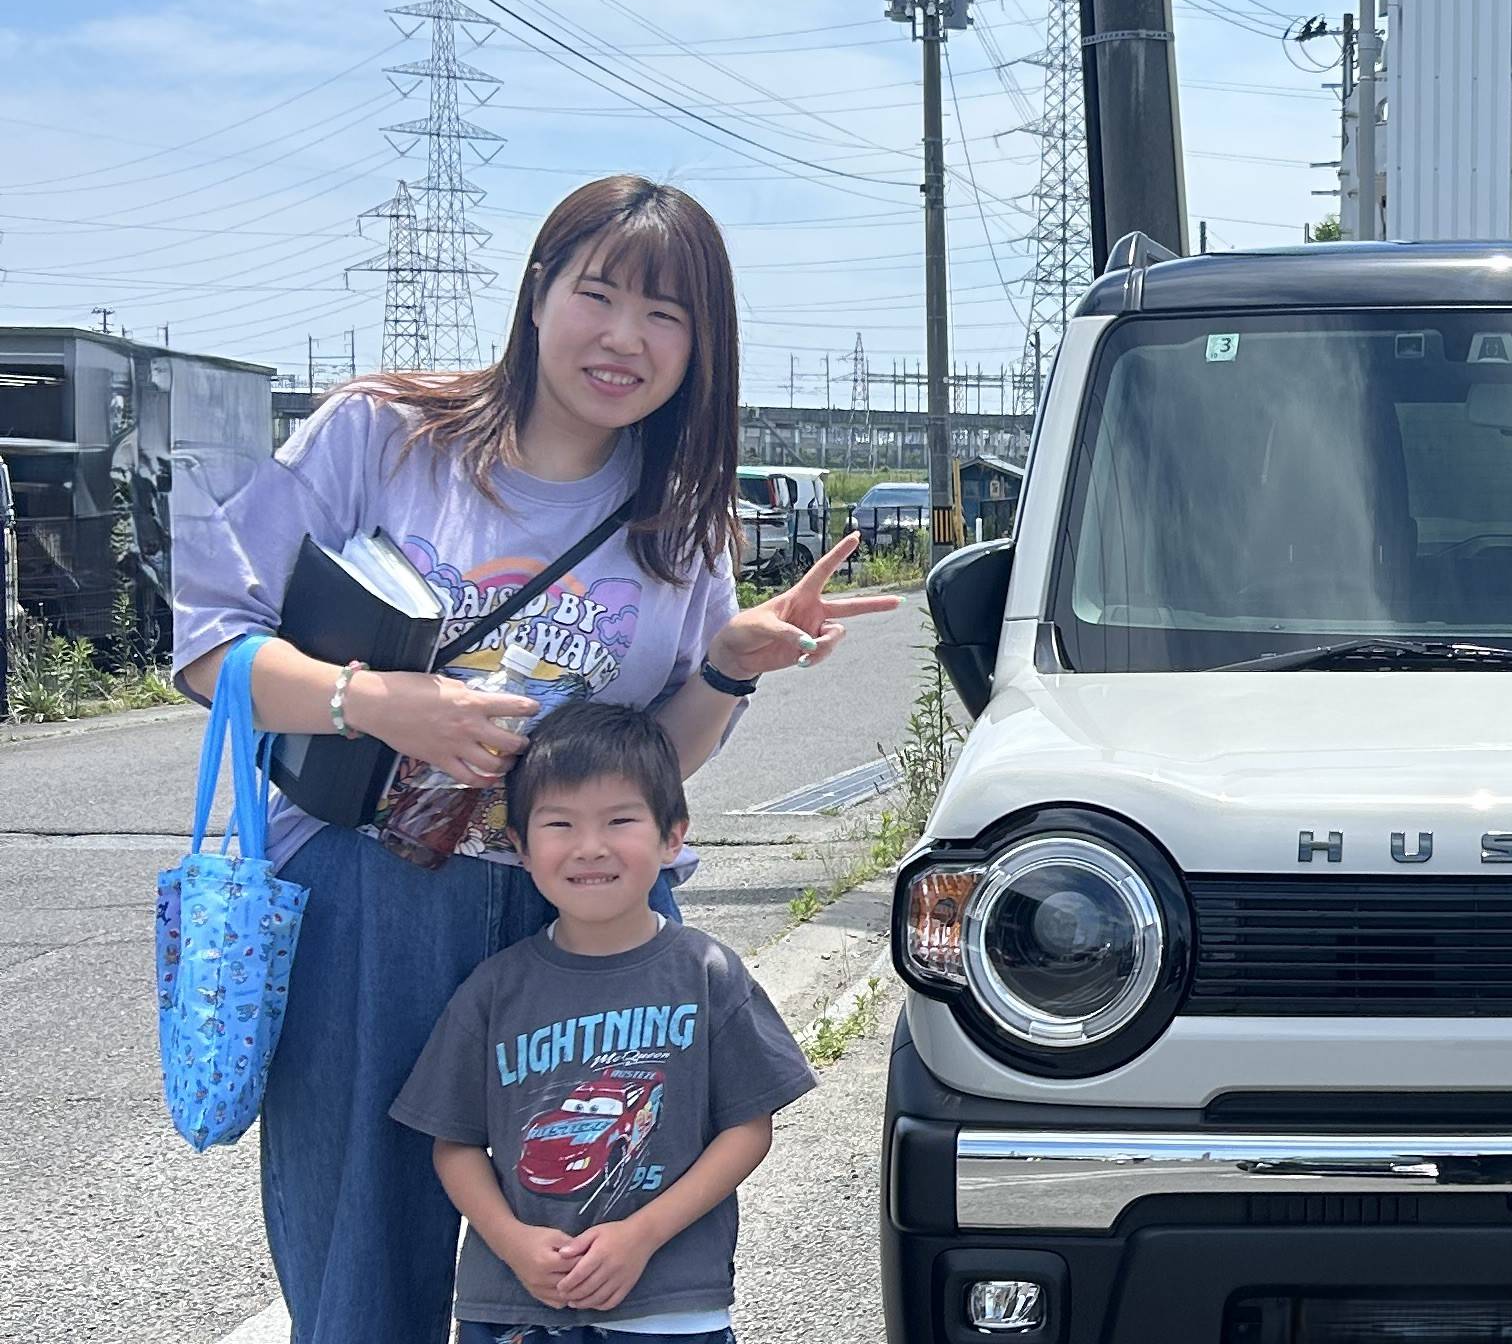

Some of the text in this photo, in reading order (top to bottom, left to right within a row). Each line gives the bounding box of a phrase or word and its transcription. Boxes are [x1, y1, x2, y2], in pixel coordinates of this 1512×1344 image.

[1220, 337, 1231, 352] 3
[553, 591, 608, 634] BY
[495, 1004, 699, 1087] LIGHTNING
[629, 1164, 666, 1191] 95
